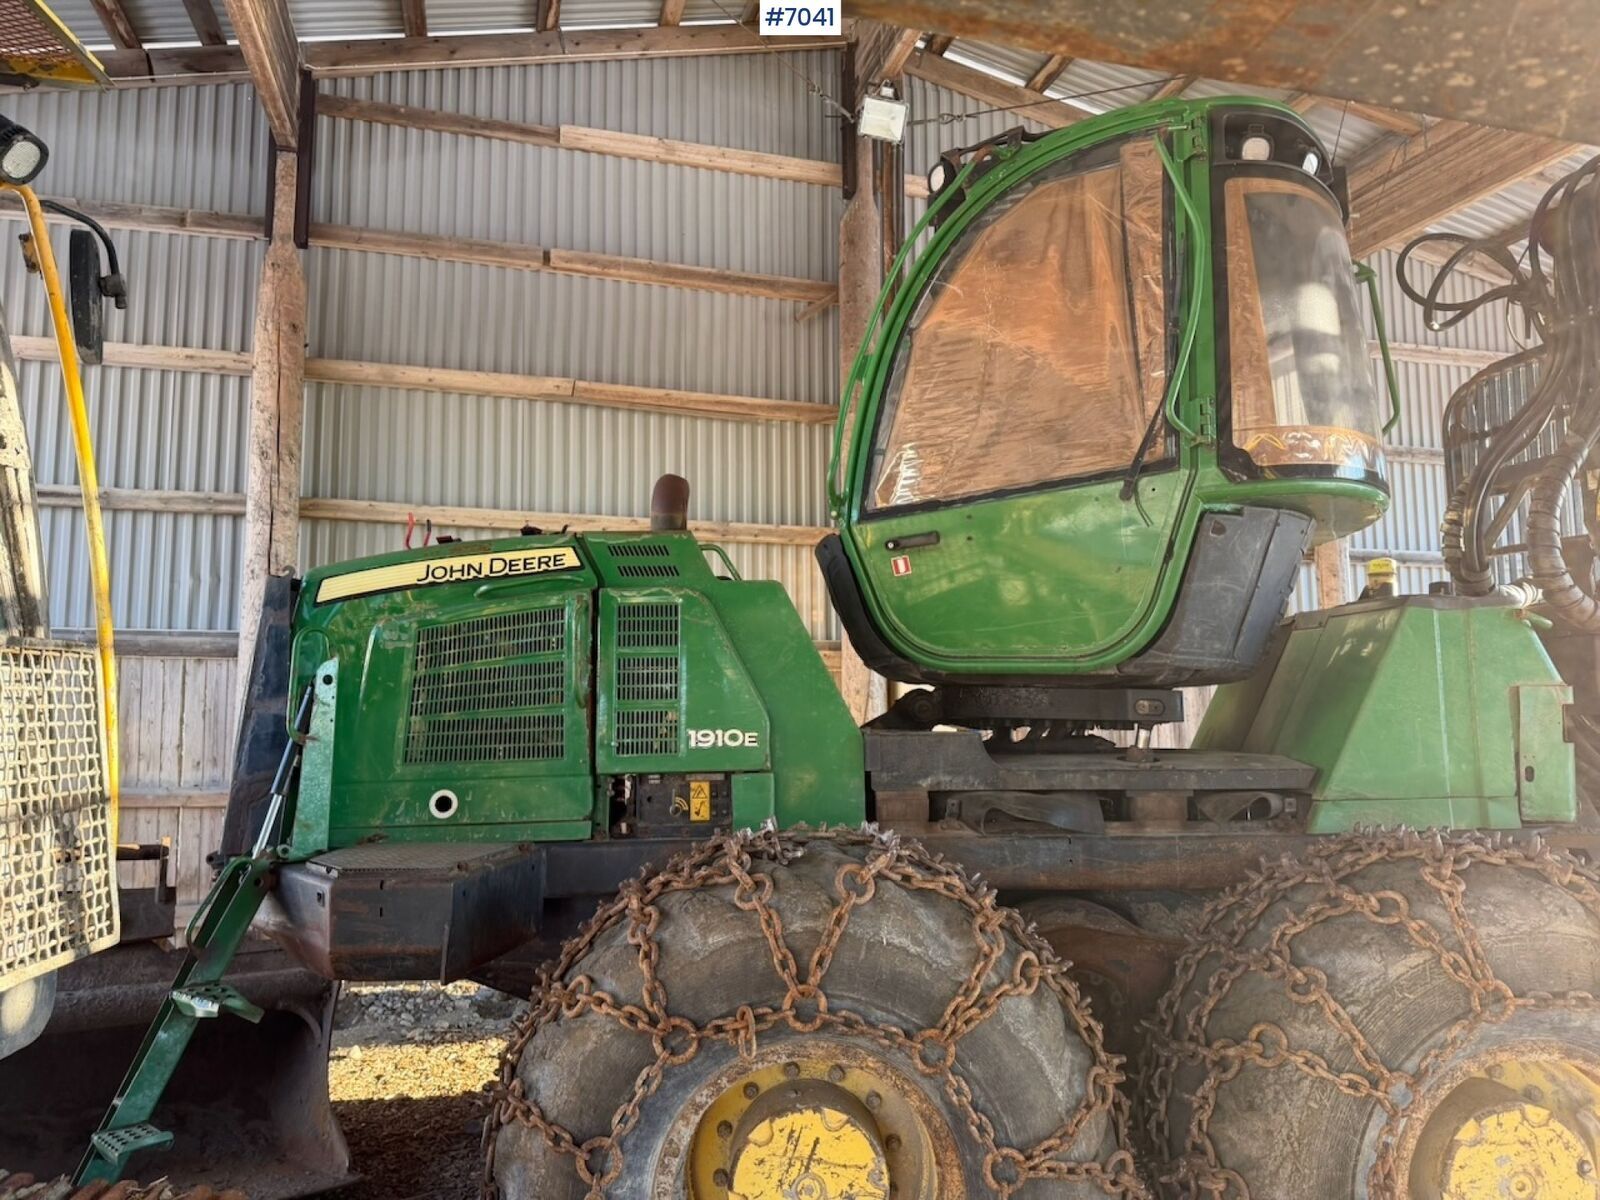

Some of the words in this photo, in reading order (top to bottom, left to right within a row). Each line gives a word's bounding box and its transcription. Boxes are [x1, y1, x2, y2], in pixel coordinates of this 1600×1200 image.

[417, 562, 482, 582] JOHN
[489, 553, 566, 575] DEERE
[687, 728, 759, 748] 1910E
